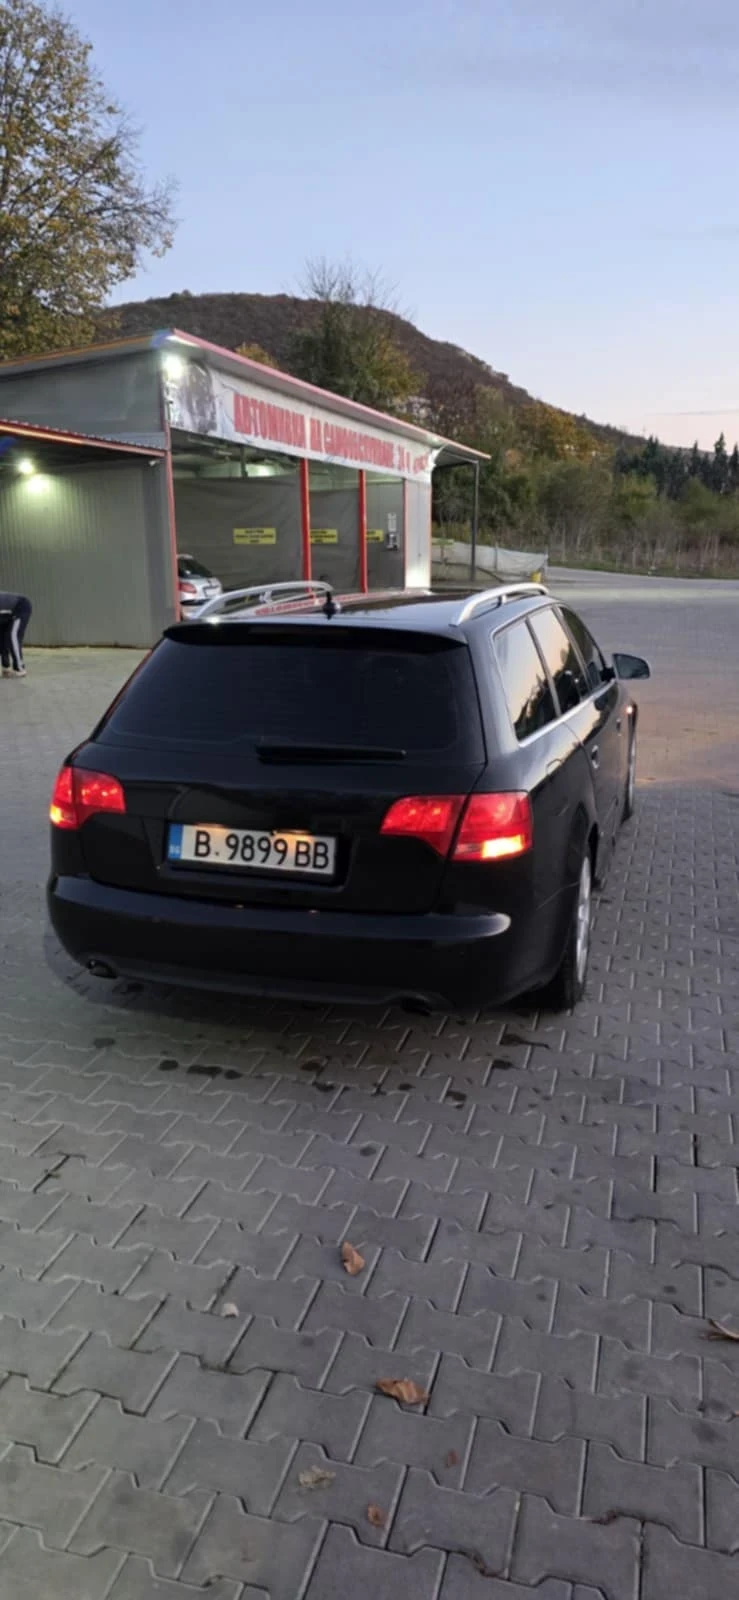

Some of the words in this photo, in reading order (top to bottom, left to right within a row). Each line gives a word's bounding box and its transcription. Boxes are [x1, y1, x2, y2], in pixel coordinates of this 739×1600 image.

[194, 830, 211, 858] B
[225, 833, 288, 865] 9899
[294, 840, 329, 869] BB
